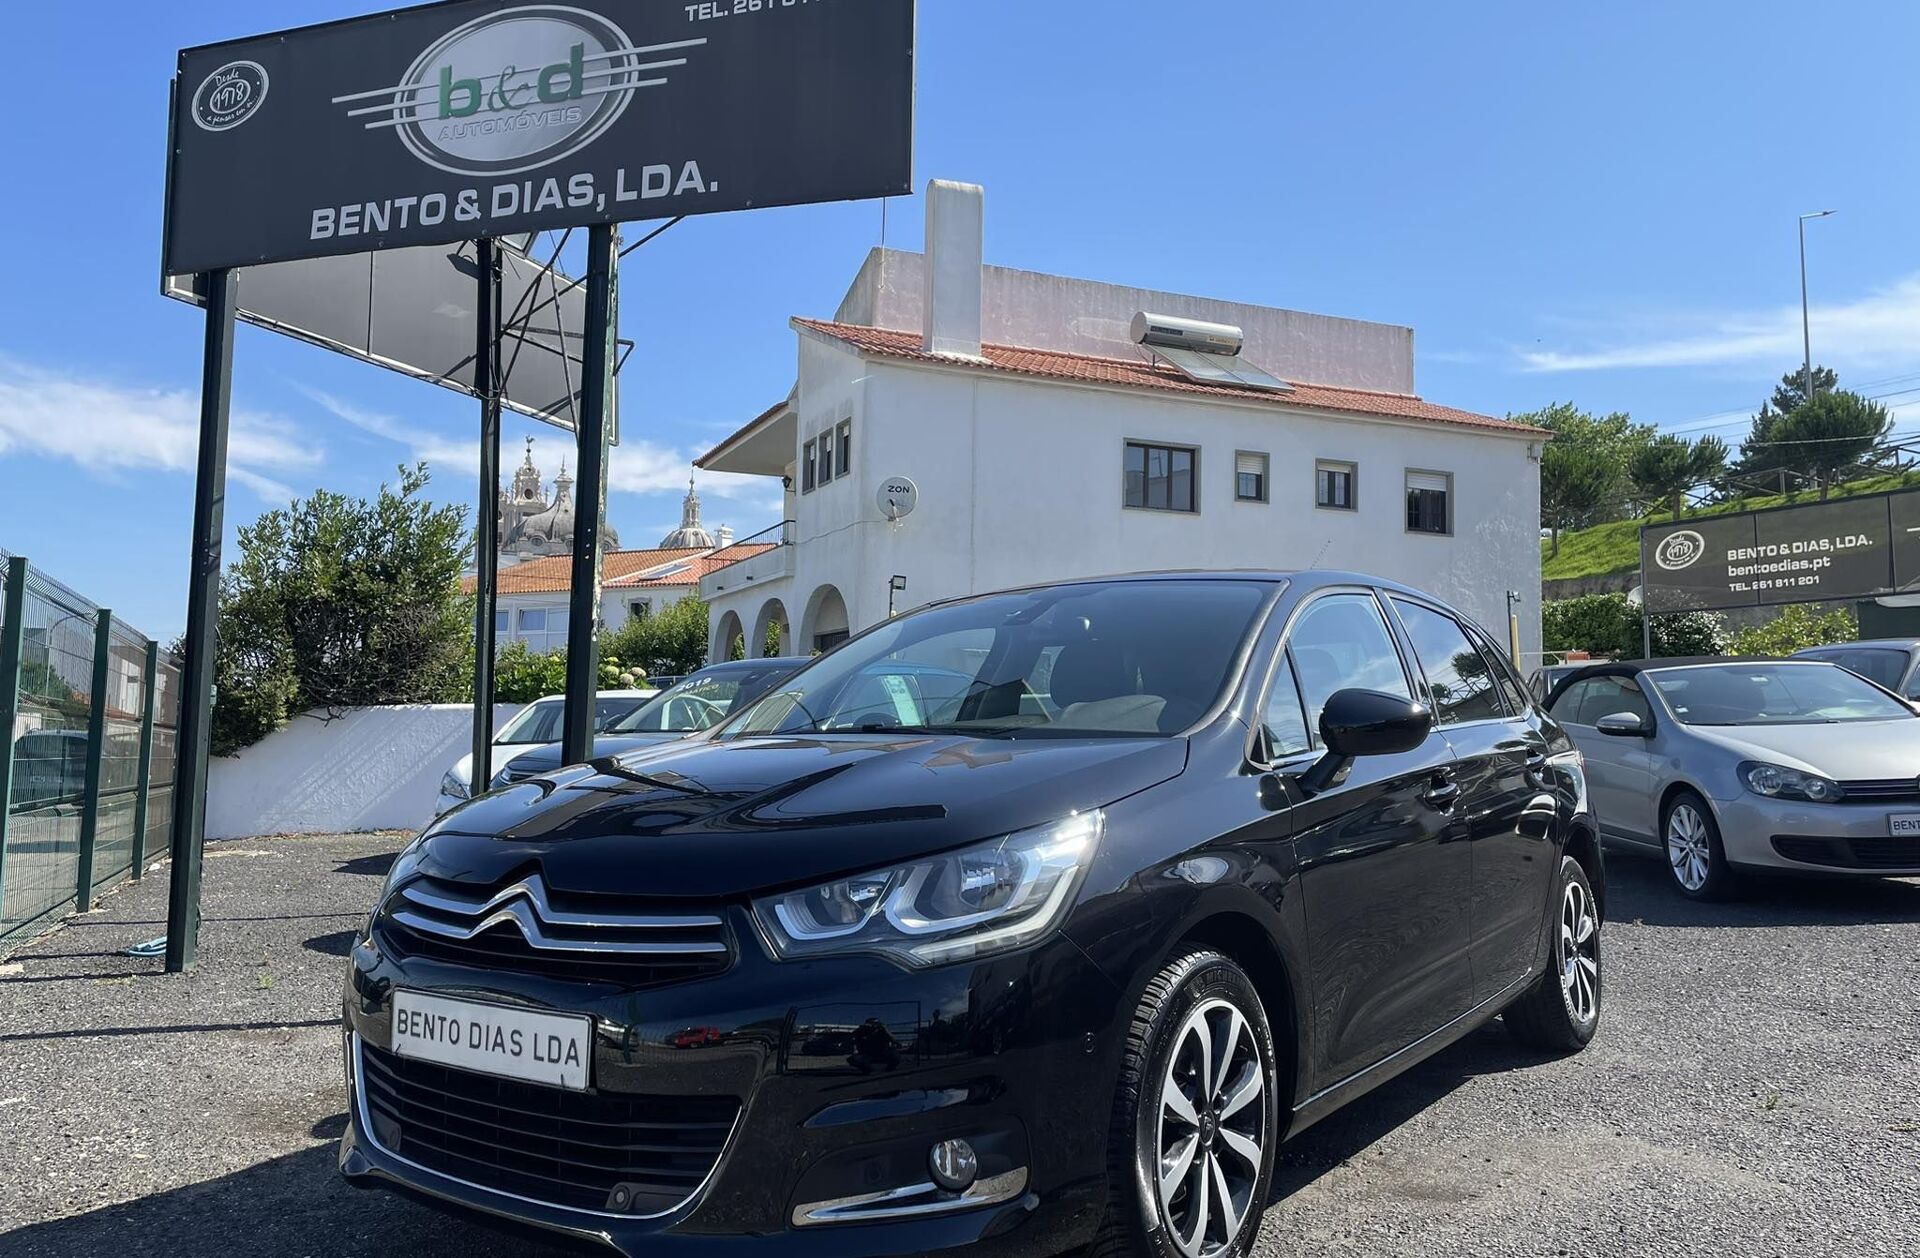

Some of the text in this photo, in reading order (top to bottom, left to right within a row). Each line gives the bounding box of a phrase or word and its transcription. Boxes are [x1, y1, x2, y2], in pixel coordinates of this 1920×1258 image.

[685, 2, 729, 22] TEL.
[215, 68, 239, 87] Desde
[214, 82, 245, 110] 1978
[438, 105, 582, 141] AUTOMÓVEIS
[310, 160, 719, 240] BENTO & DIAS, LDA.
[887, 485, 910, 494] ZON
[1727, 534, 1873, 561] BENTO & DIAS, LDA.
[1728, 556, 1831, 577] bentoedias.pt
[1729, 575, 1820, 592] TEL. 261 811 201
[397, 1008, 580, 1068] BENTO DIAS LDA
